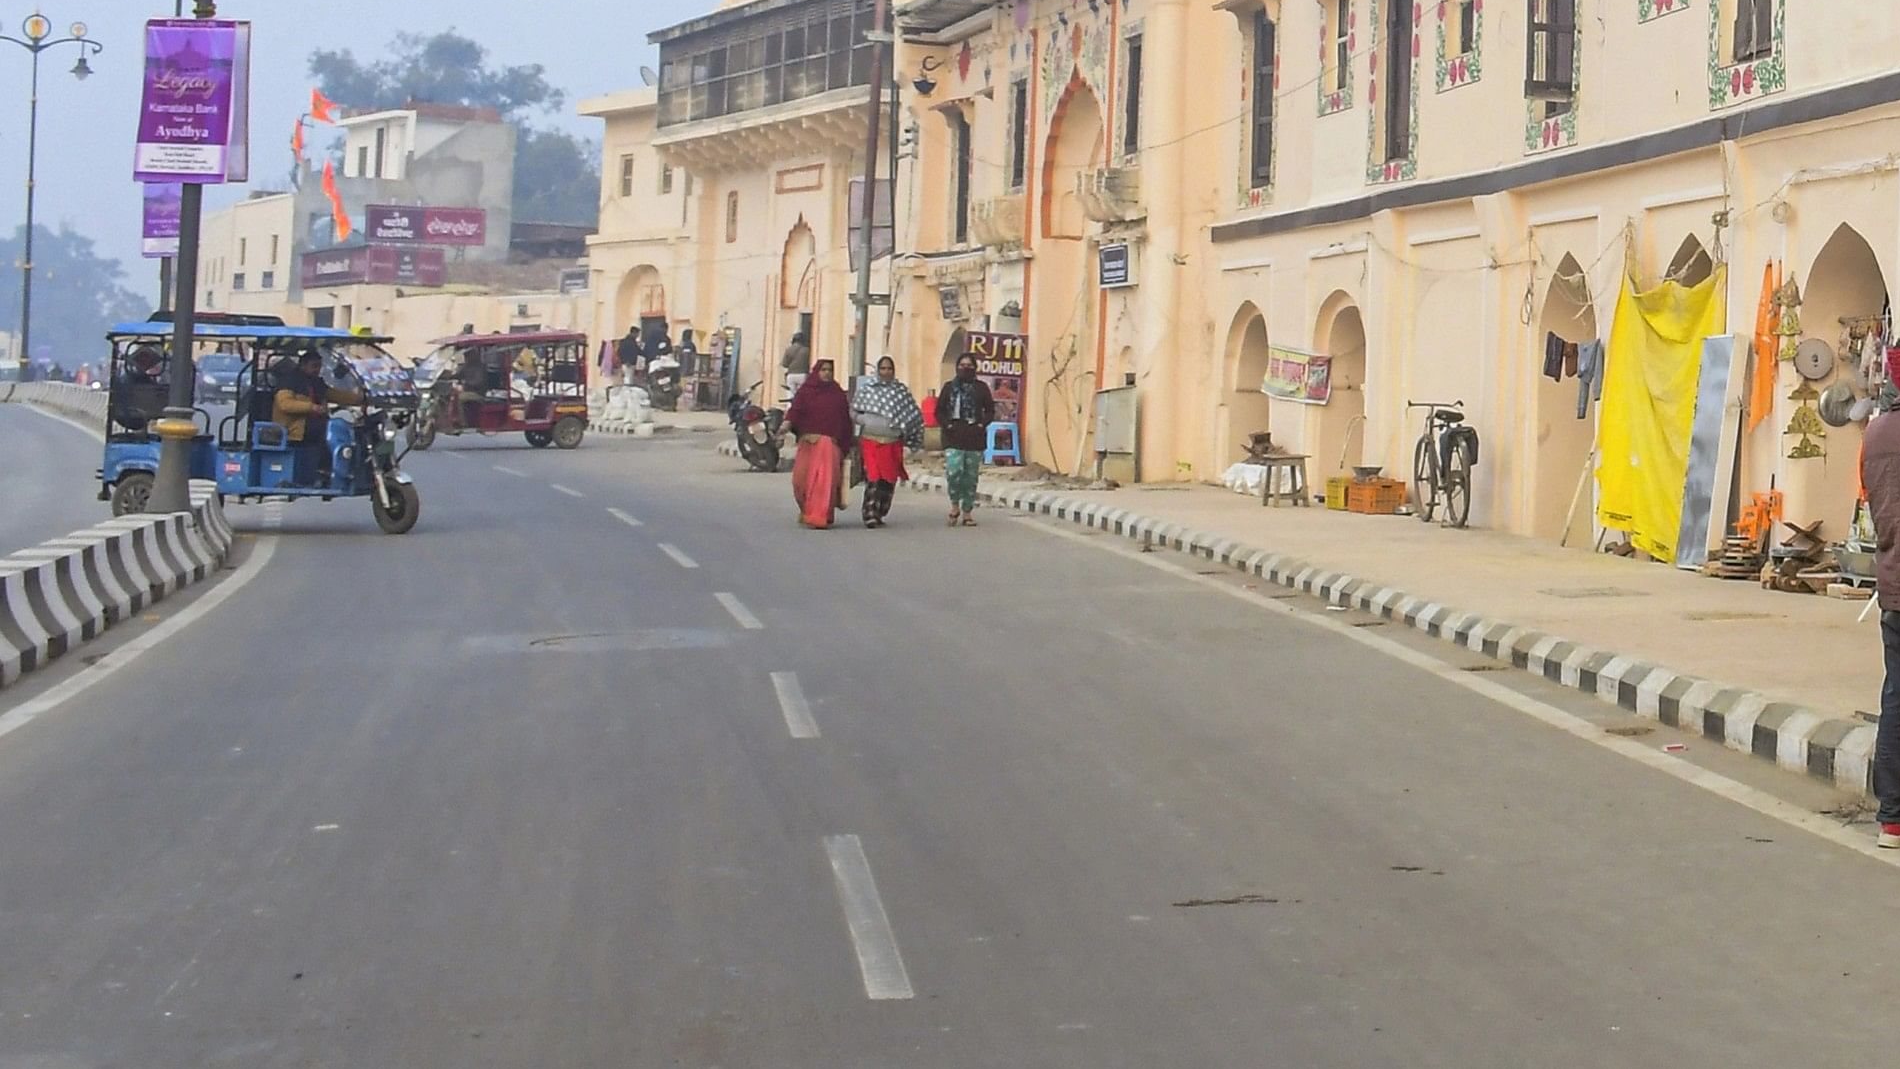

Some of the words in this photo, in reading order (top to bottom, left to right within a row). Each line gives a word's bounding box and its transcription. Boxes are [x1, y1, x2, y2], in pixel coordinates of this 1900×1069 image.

[155, 125, 209, 141] Ayodhya
[970, 335, 999, 359] RJ
[1002, 338, 1023, 359] 11
